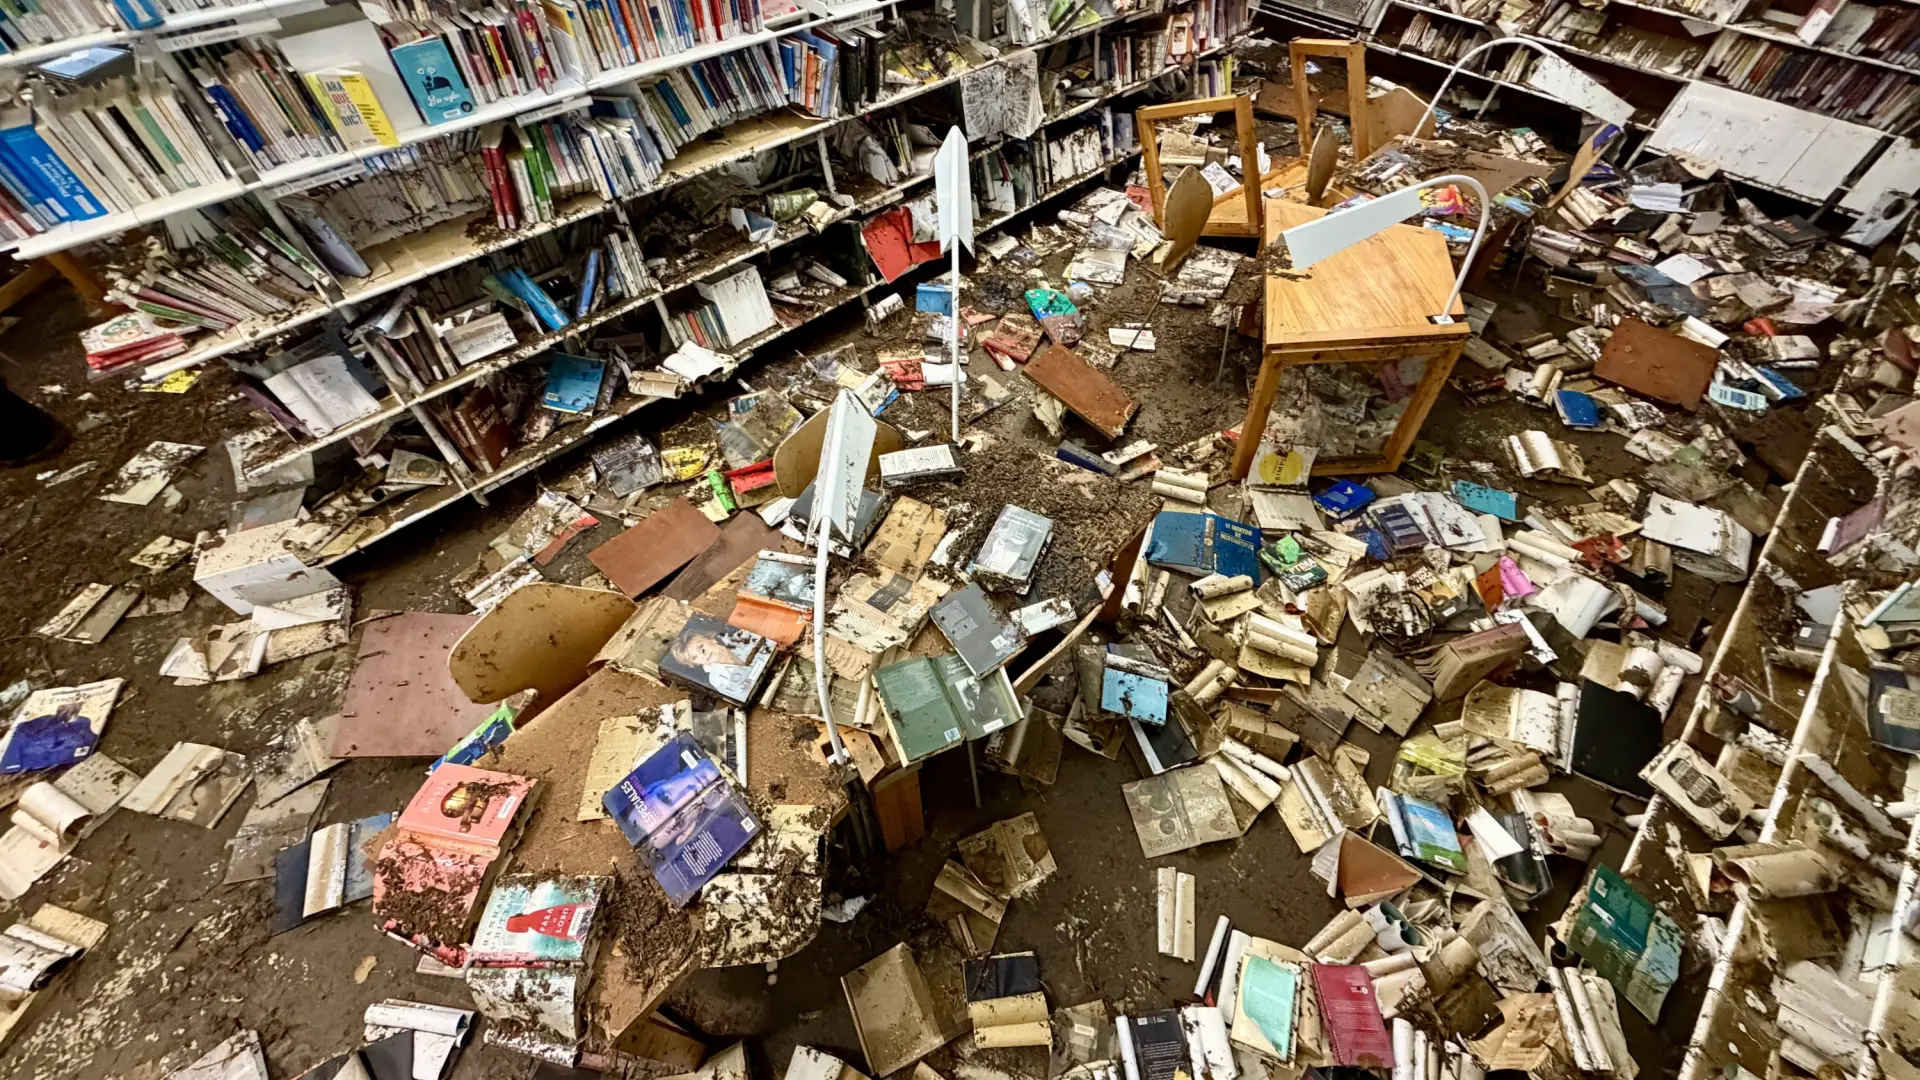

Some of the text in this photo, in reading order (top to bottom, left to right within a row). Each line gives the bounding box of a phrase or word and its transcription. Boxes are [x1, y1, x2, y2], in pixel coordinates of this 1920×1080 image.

[325, 81, 345, 92] ARA
[341, 115, 363, 126] DIC?
[620, 780, 657, 827] ESPECIALES
[482, 894, 506, 947] HANNAH
[540, 908, 554, 932] PARA
